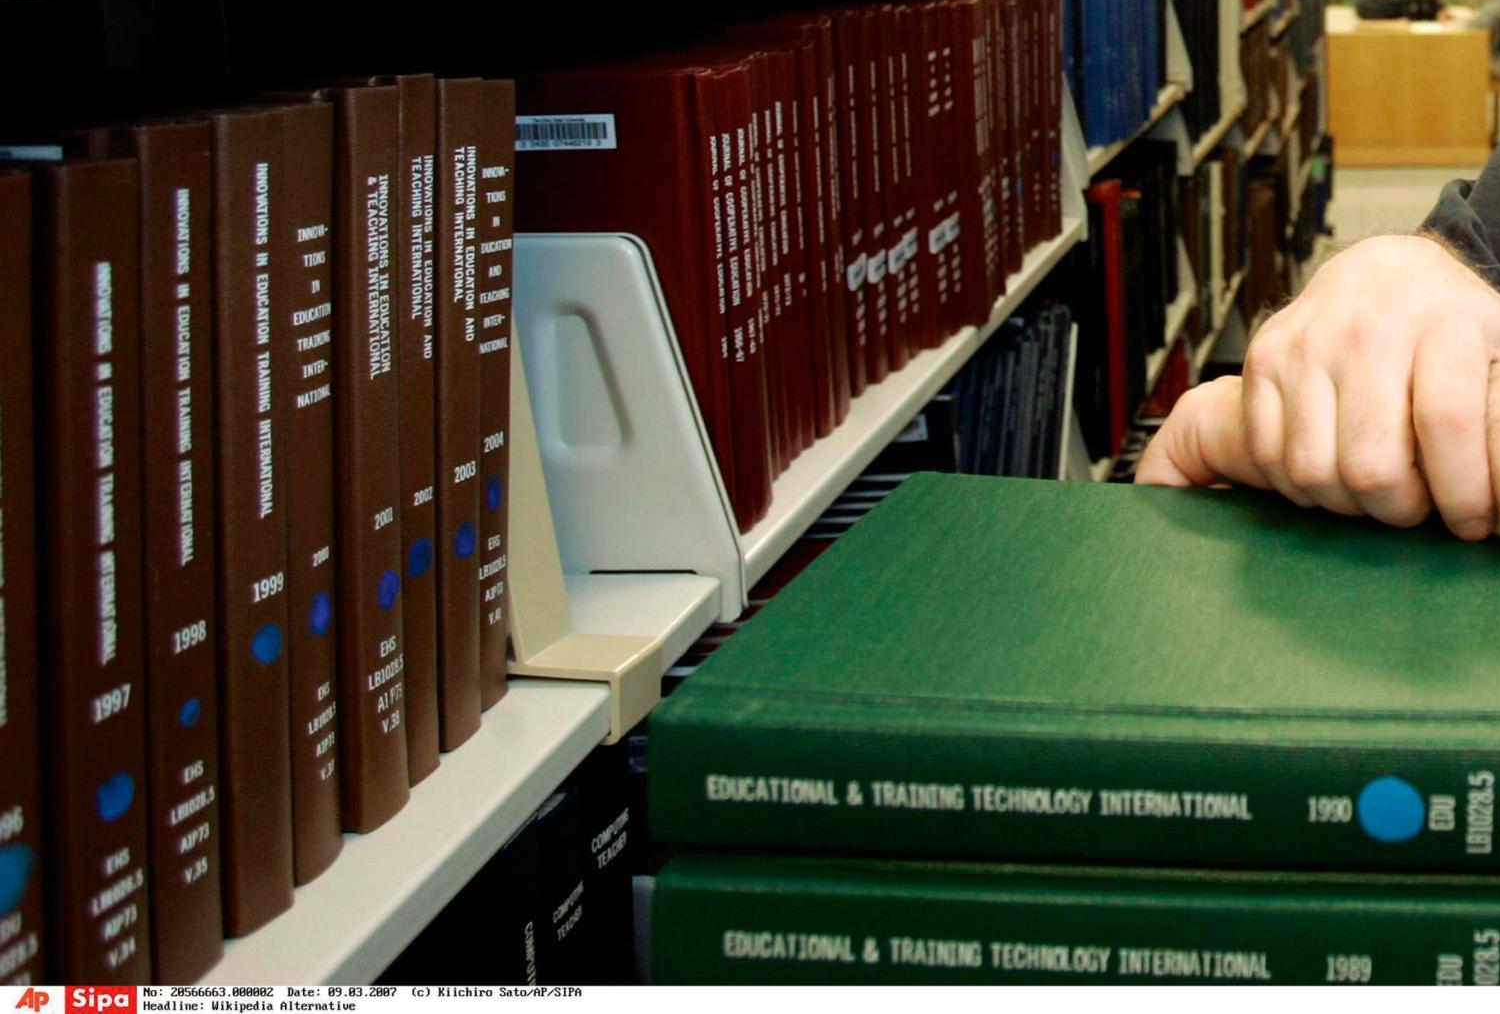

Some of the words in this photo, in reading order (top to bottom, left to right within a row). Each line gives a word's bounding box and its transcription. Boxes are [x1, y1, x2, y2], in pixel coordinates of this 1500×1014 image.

[255, 162, 269, 245] INNOVATIONS
[367, 176, 377, 186] &
[411, 156, 421, 218] TEACHING
[423, 155, 434, 233] INNOVATIONS
[454, 147, 464, 205] TEACHING
[466, 146, 476, 220] INNOVATIONS
[176, 188, 190, 275] INNOVATIONS
[367, 191, 379, 262] TEACHING
[378, 174, 389, 269] INNOVATIONS
[424, 240, 433, 253] IN
[466, 227, 476, 240] IN
[256, 252, 269, 267] IN
[303, 251, 326, 267] TIONS
[379, 273, 389, 291] IN
[412, 224, 422, 320] INTERNATIONAL
[454, 212, 464, 303] INTERNATIONAL
[465, 246, 475, 310] EDUCATION
[488, 265, 502, 278] AND
[177, 284, 190, 298] IN
[256, 273, 270, 345] EDUCATION
[424, 259, 433, 327] EDUCATION
[177, 305, 191, 381] EDUCATION
[368, 267, 381, 380] INTERNATIONAL
[379, 294, 392, 374] EDUCATION
[424, 334, 433, 359] AND
[465, 317, 474, 342] AND
[258, 351, 271, 413] TRAINING
[178, 387, 192, 454] TRAINING
[484, 431, 504, 453] 2004
[259, 419, 273, 519] INTERNATIONAL
[414, 486, 433, 506] 2002
[454, 461, 476, 483] 2003
[179, 460, 194, 567] INTERNATIONAL
[374, 507, 393, 530] 2001
[253, 572, 284, 604] 1999
[173, 620, 207, 654] 1998
[380, 635, 396, 658] EHS
[93, 683, 132, 724] 1997
[183, 760, 204, 784] EHS
[707, 774, 839, 806] EDUCATIONAL
[846, 780, 862, 805] &
[872, 781, 964, 810] TRAINING
[971, 785, 1092, 815] TECHNOLOGY
[1099, 790, 1253, 821] INTERNATIONAL
[1307, 796, 1353, 823] 1990
[1428, 794, 1456, 831] EDU
[1466, 769, 1495, 854] LB1028.5
[724, 929, 855, 962] EDUCATIONAL
[862, 937, 880, 963] &
[890, 937, 982, 969] TRAINING
[990, 942, 1110, 974] TECHNOLOGY
[1118, 948, 1272, 979] INTERNATIONAL
[1325, 954, 1372, 984] 1989
